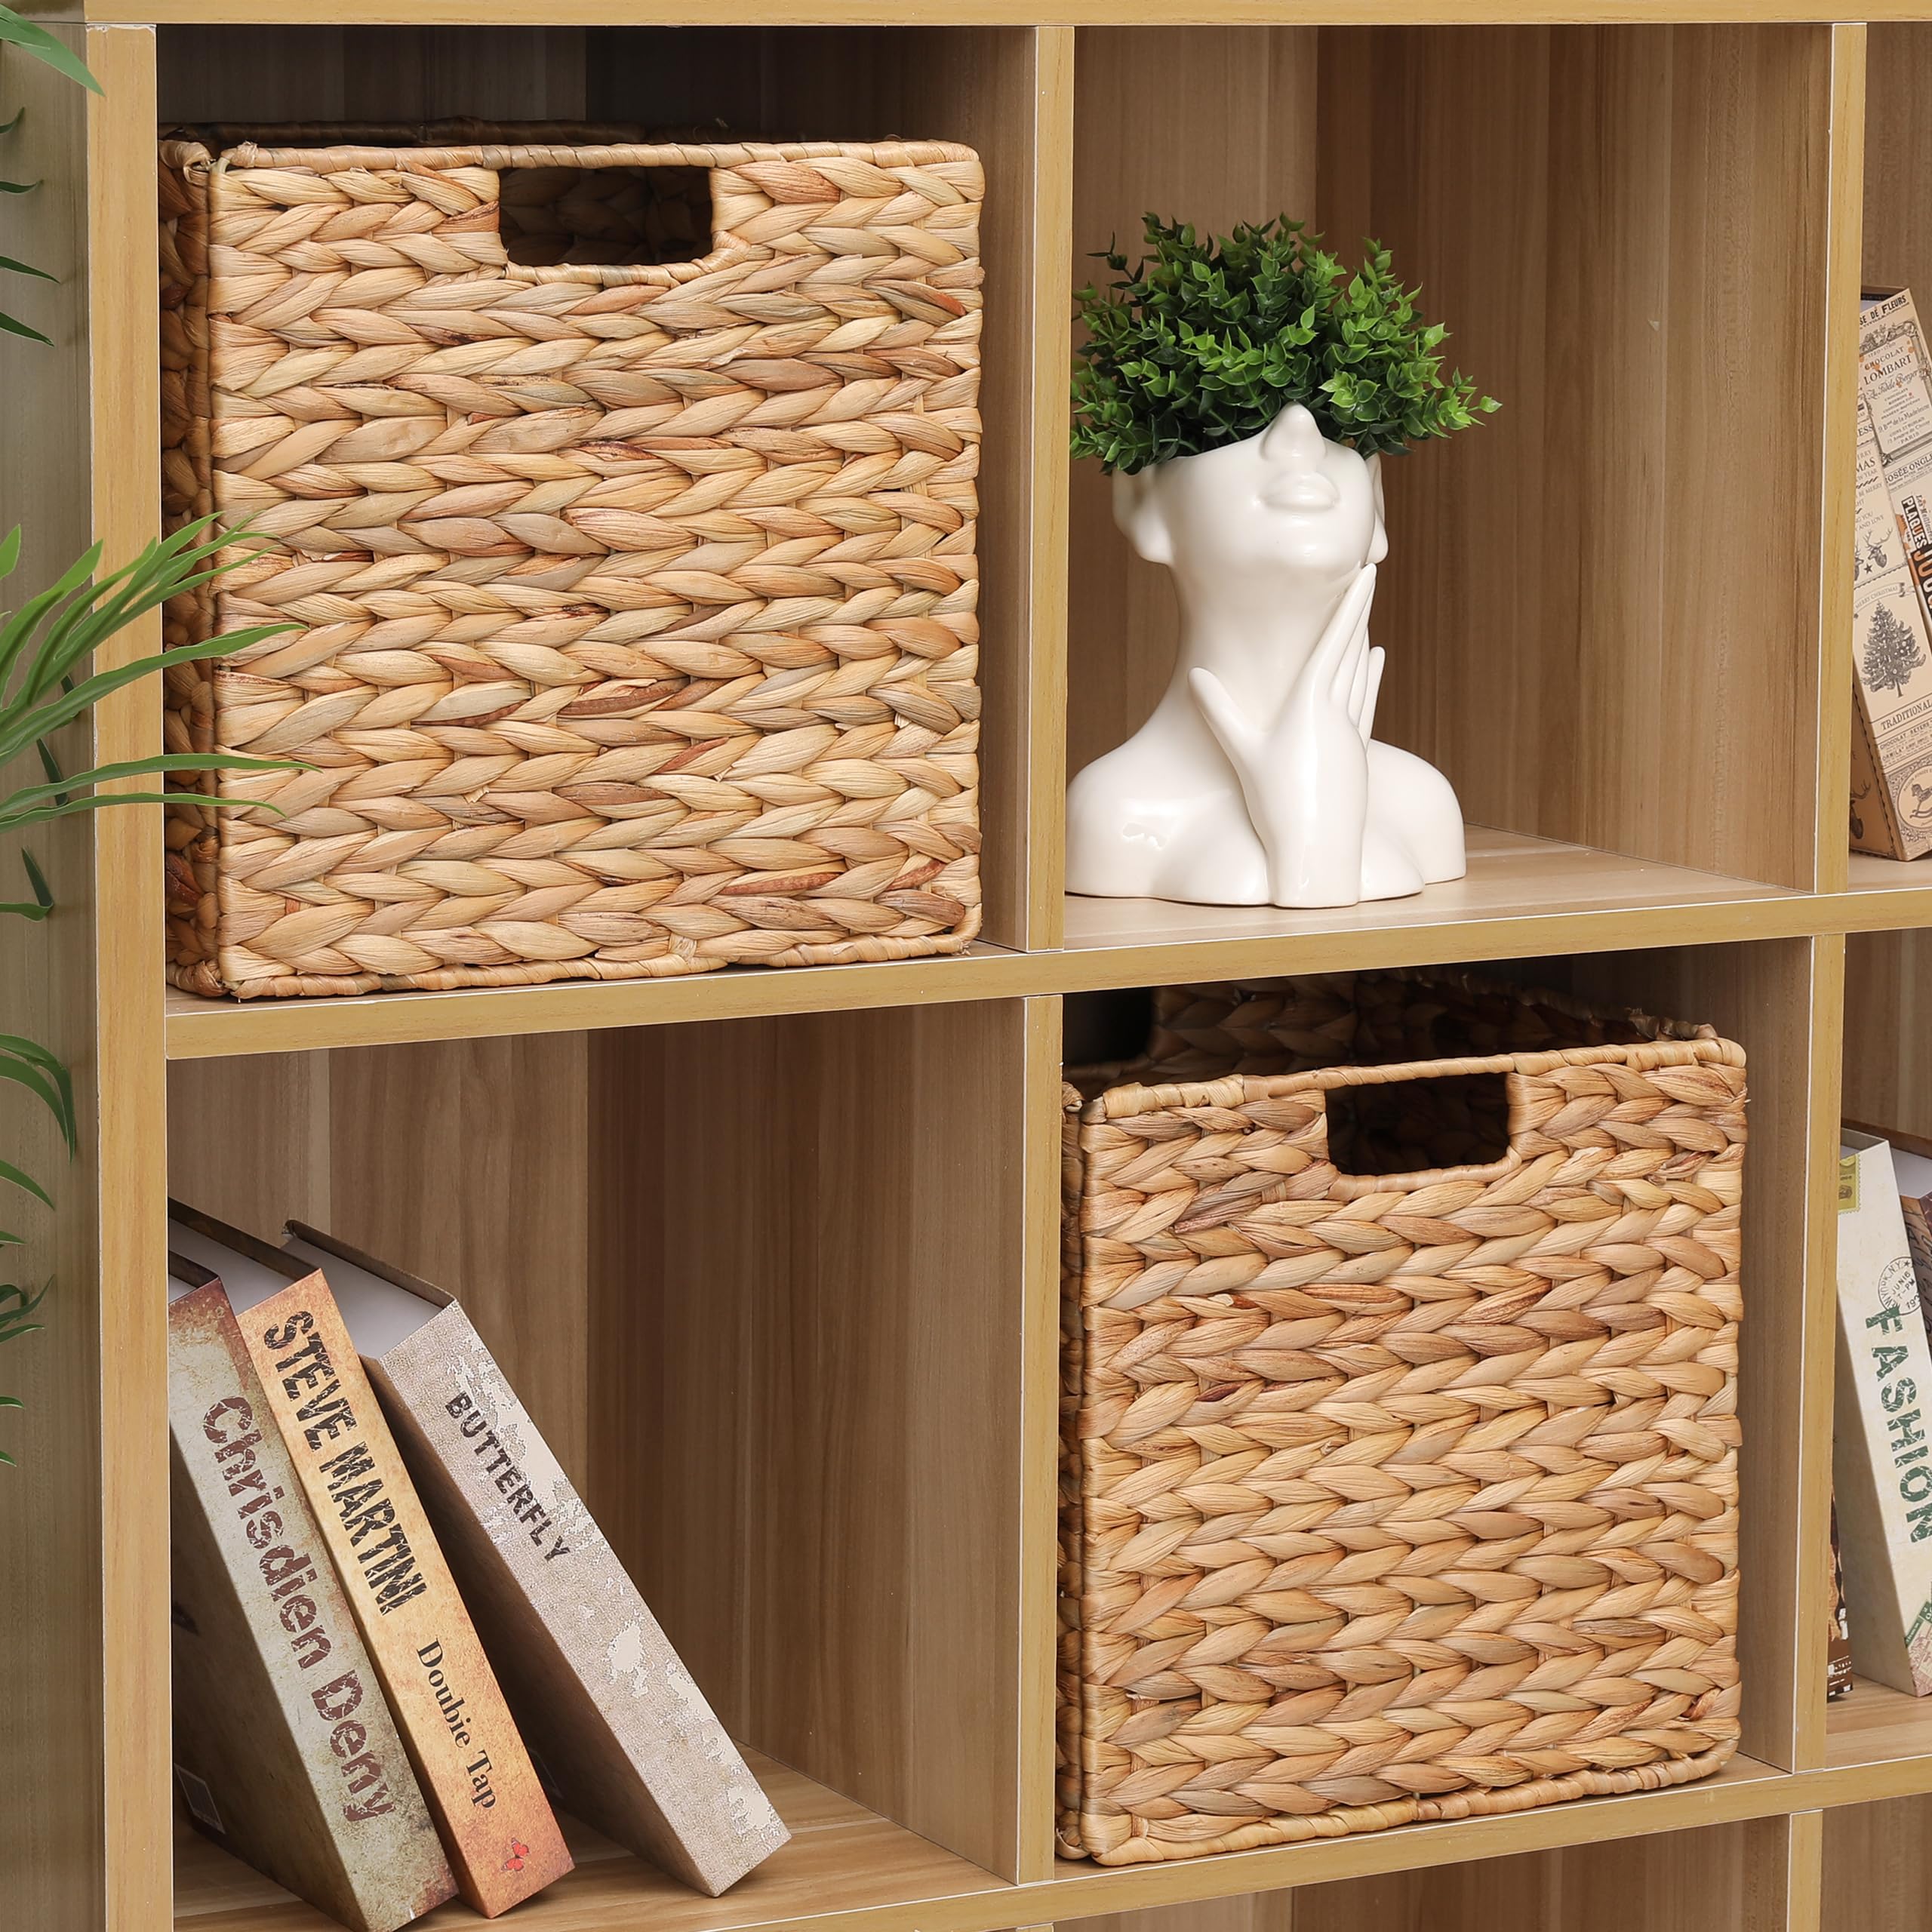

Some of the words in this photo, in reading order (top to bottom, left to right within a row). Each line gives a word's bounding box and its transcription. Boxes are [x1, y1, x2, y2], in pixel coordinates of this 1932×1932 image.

[1881, 295, 1906, 314] FLEURS
[1864, 355, 1911, 385] LOMBART
[1865, 346, 1904, 370] CHOCOLAT
[1901, 432, 1919, 444] PARIS
[1903, 497, 1927, 549] PLAQUES
[1881, 700, 1932, 731] TRADITIONAL
[1865, 1304, 1932, 1543] FASHION
[265, 1311, 356, 1452] STEVE
[320, 1441, 427, 1616] MARTINI
[445, 1391, 571, 1562] BUTTERFLY
[203, 1396, 332, 1669] Chrisdien
[312, 1669, 395, 1823] Deny
[417, 1637, 472, 1749] Doubie
[466, 1749, 497, 1810] Tap
